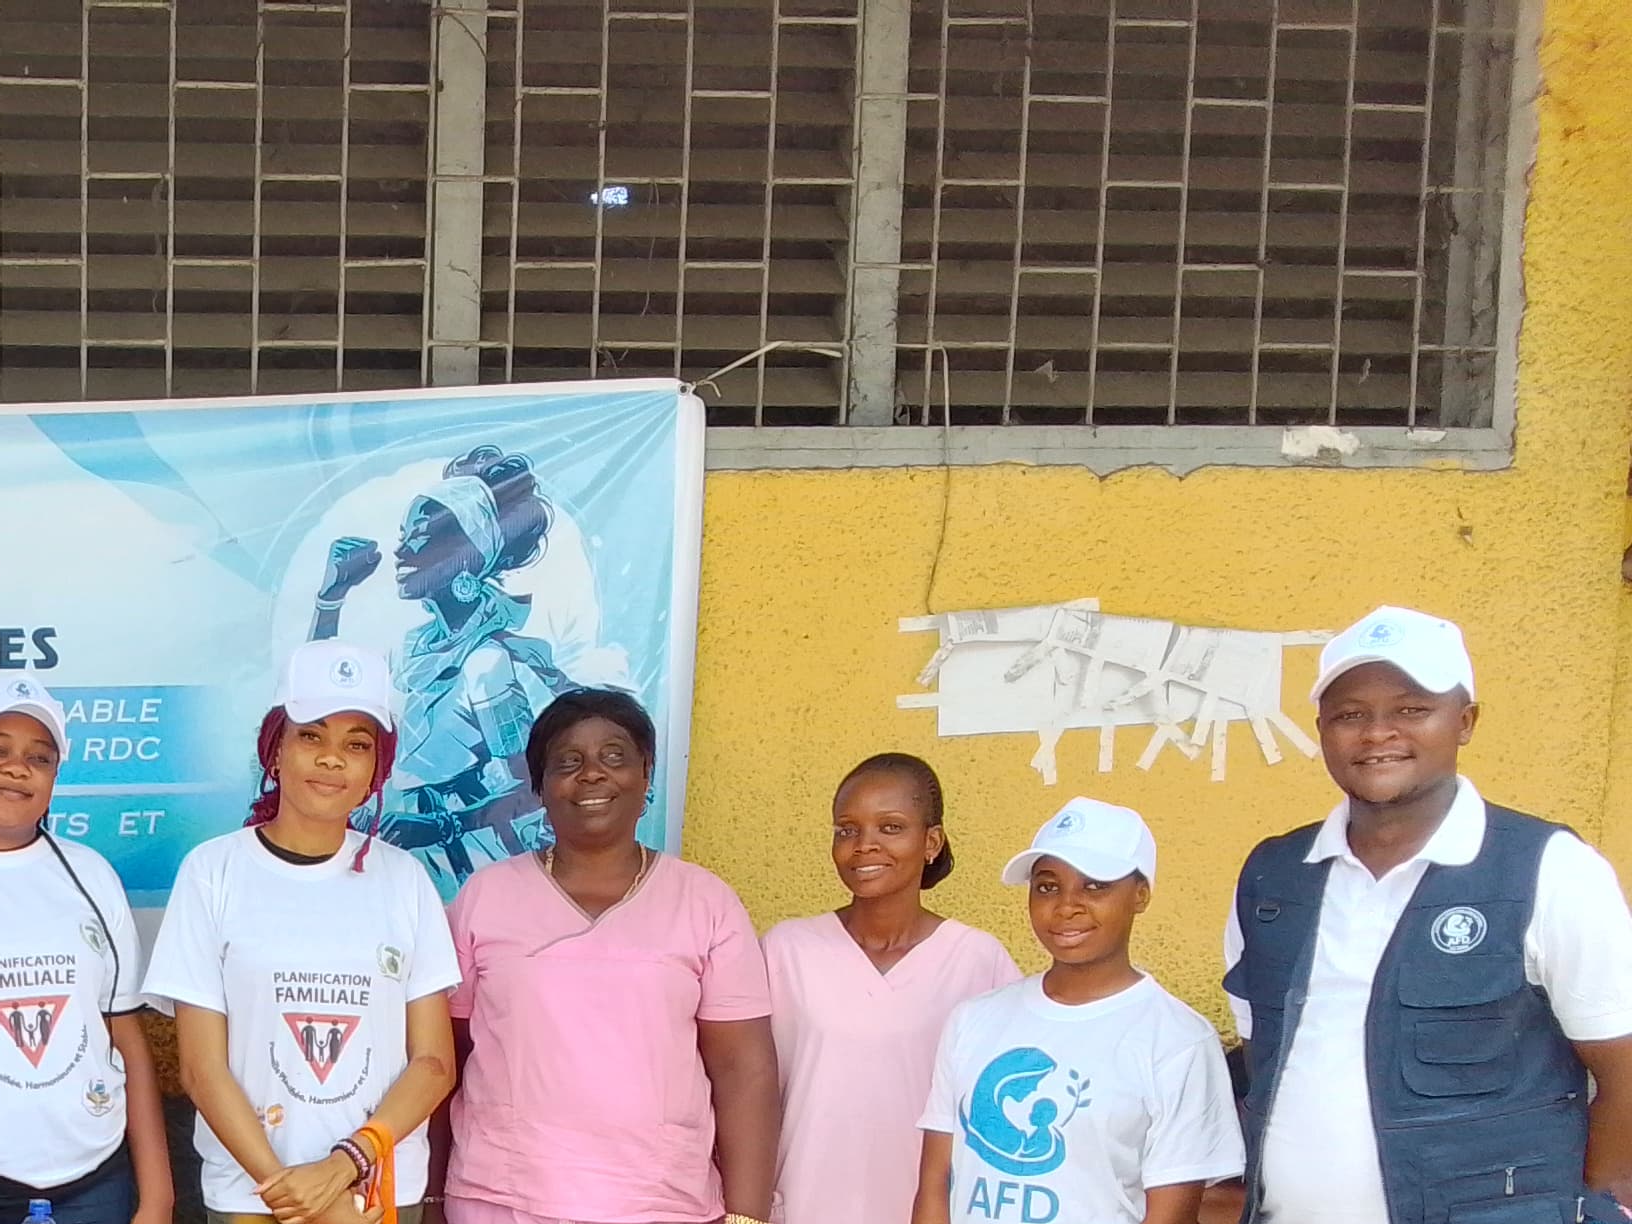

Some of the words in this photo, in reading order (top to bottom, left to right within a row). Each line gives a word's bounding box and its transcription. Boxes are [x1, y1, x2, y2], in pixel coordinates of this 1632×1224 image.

[66, 697, 163, 724] ABLE
[82, 736, 161, 762] RDC
[118, 810, 166, 837] ET
[273, 971, 373, 988] PLANIFICATION
[275, 986, 371, 1006] FAMILIALE
